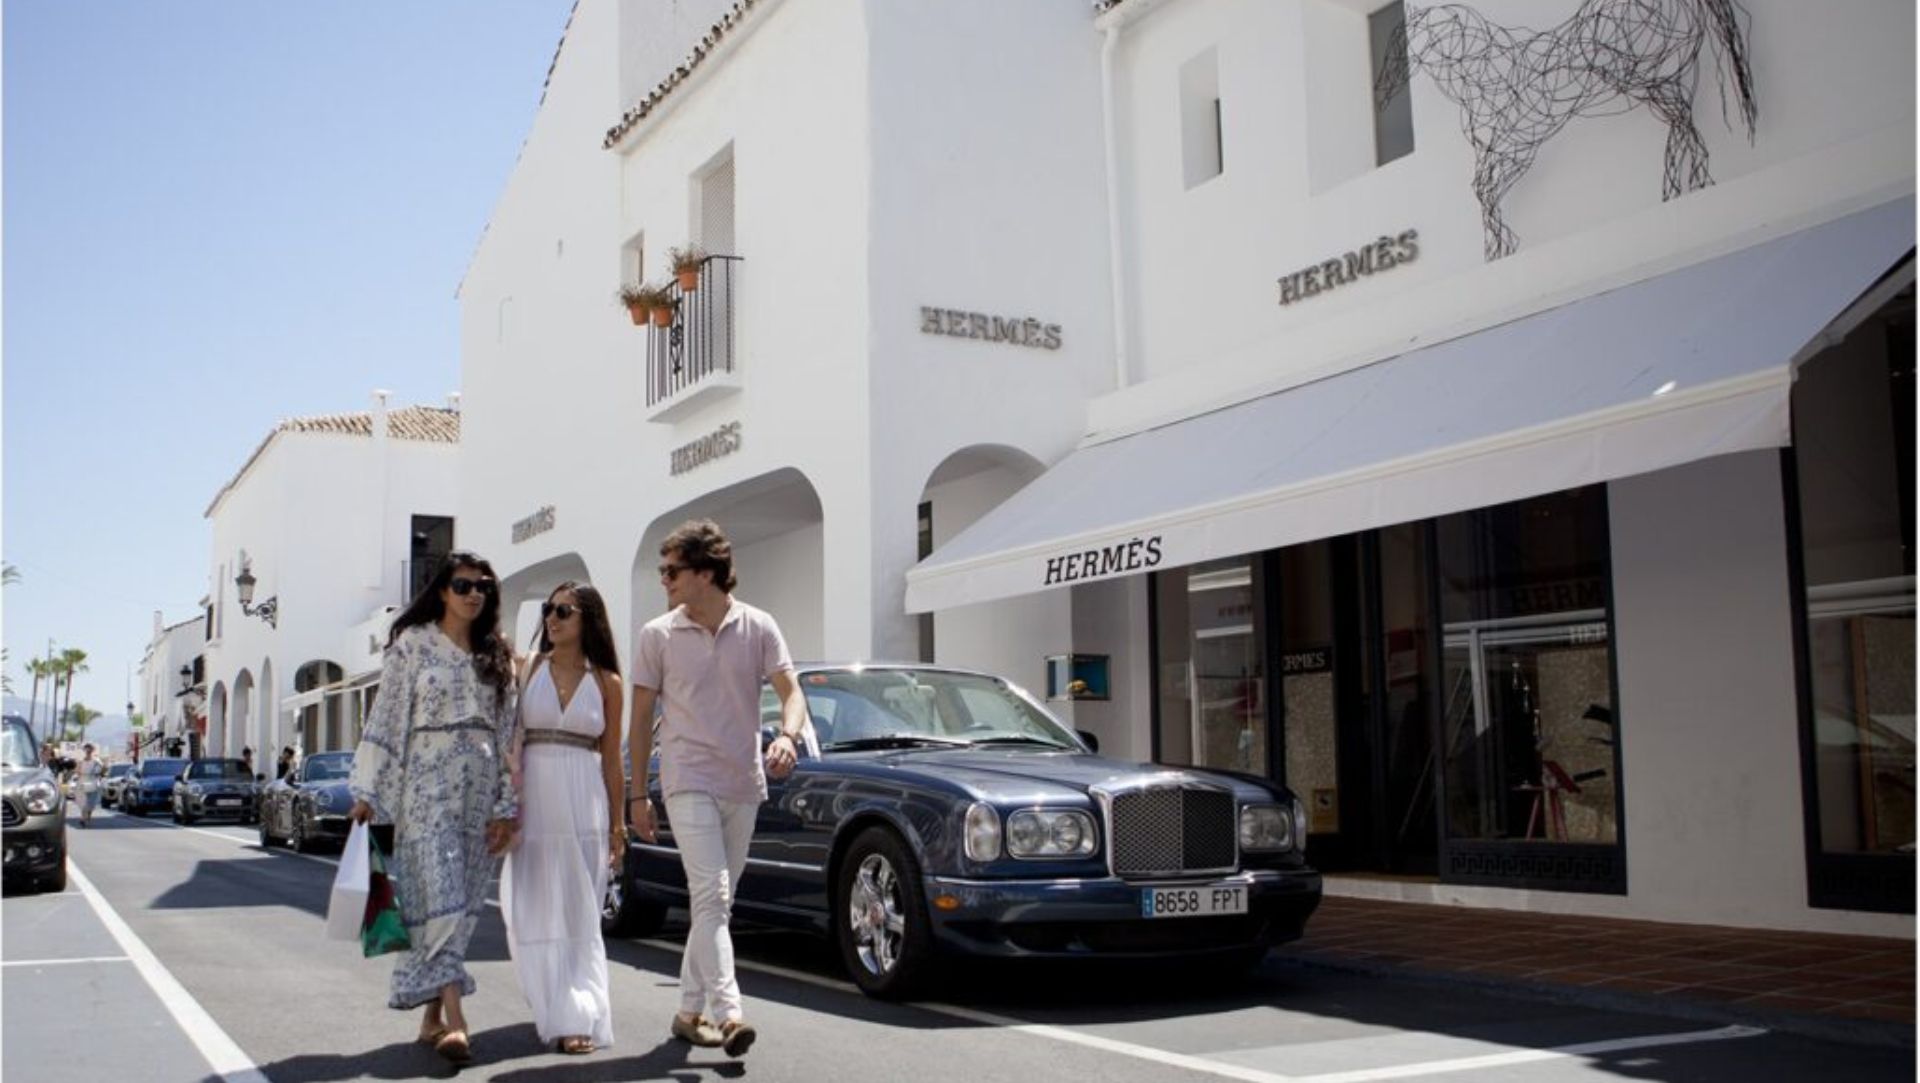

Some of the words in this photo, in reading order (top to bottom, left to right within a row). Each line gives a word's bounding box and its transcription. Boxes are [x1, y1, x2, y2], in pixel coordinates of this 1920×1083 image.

[1277, 229, 1419, 305] HERMÈS
[920, 306, 1063, 351] HERMÈS
[1044, 536, 1162, 586] HERMÈS
[1155, 890, 1199, 913] 8658
[1211, 888, 1241, 910] FPT
